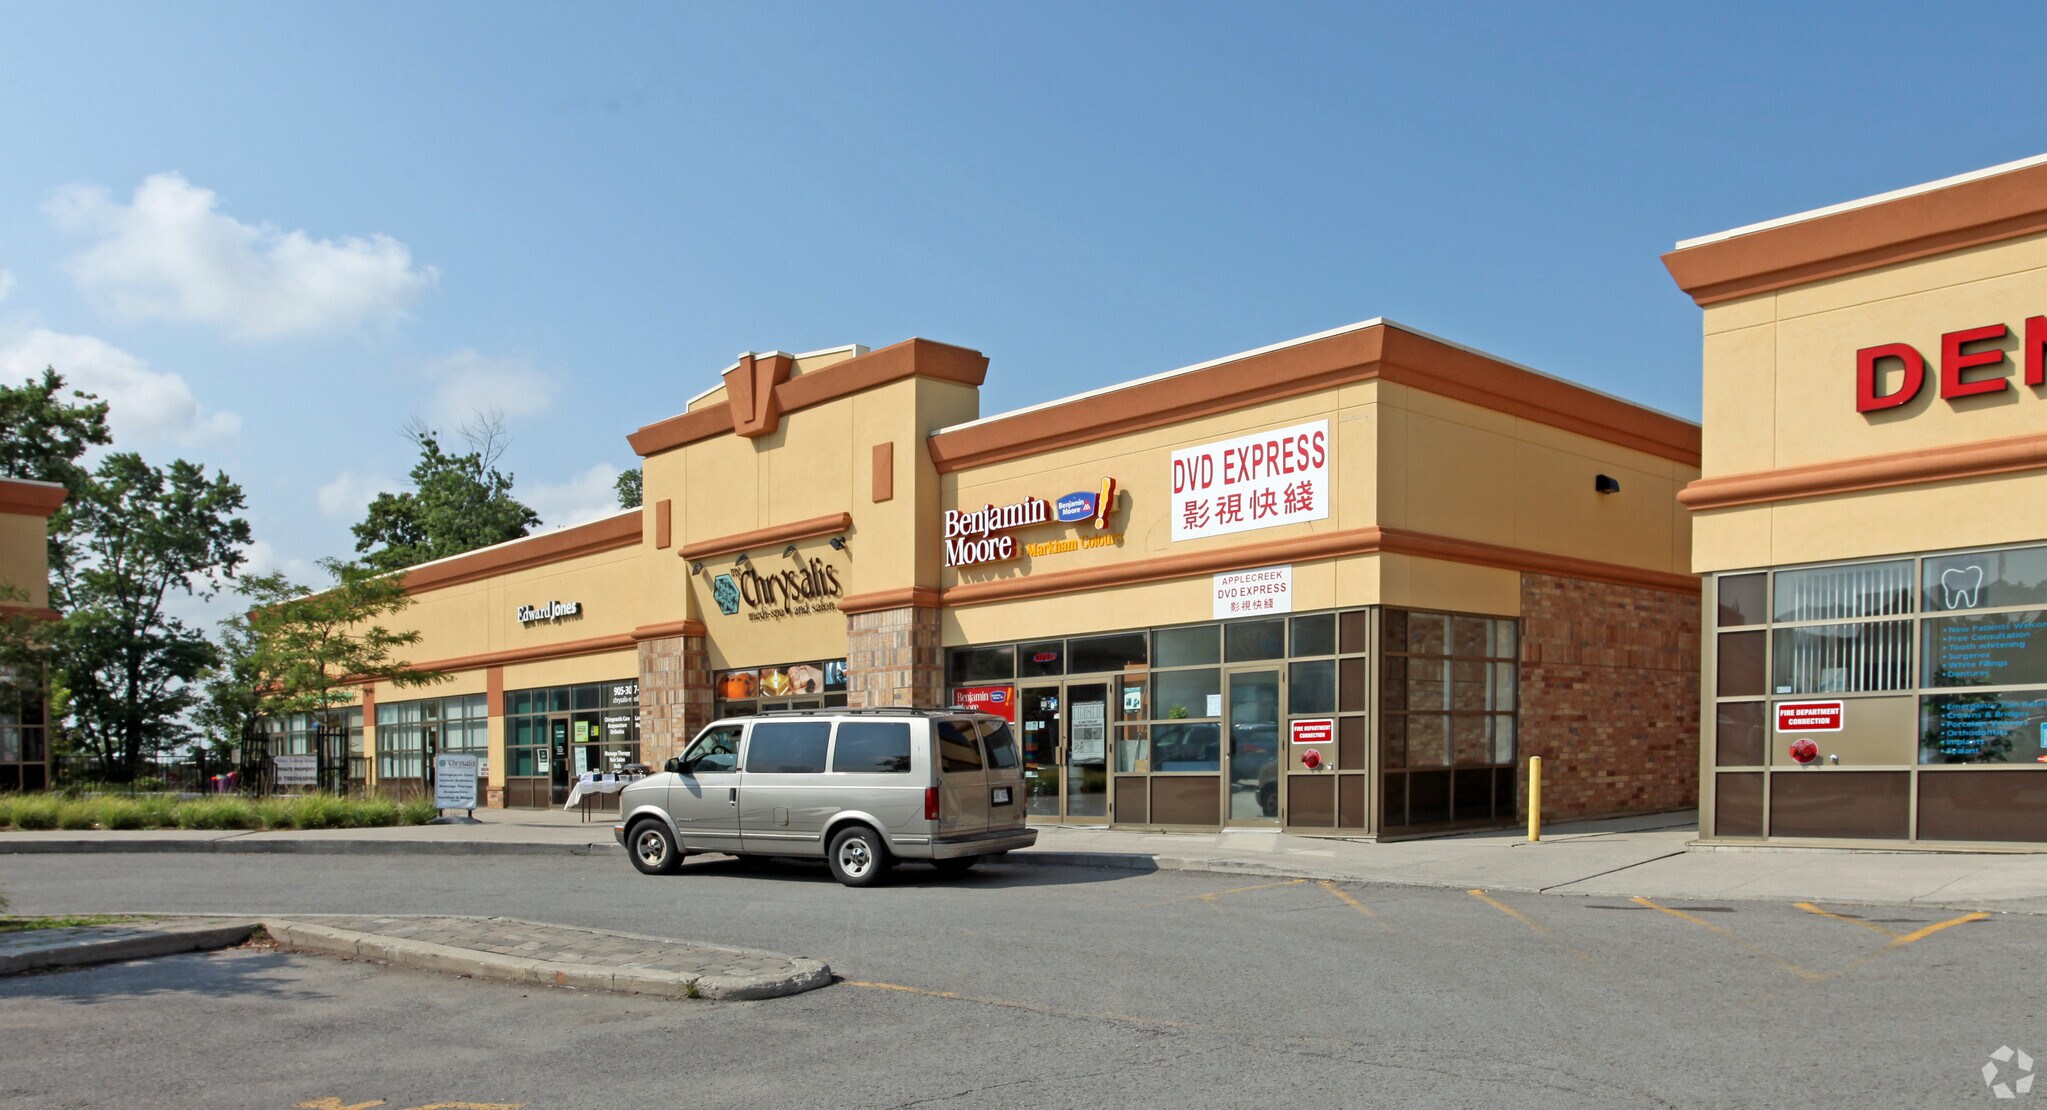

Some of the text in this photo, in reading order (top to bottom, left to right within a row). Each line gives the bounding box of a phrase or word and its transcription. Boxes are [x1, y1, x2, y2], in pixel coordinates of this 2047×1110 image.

[1173, 430, 1326, 495] DVD EXPRESS
[1058, 498, 1084, 509] Benjamin
[1183, 480, 1314, 530] 影視快綫
[1062, 507, 1081, 515] Moore
[945, 496, 1047, 538] Benjamin
[945, 535, 1012, 567] Moore
[1027, 538, 1078, 557] Markham
[1221, 571, 1283, 586] APPLECREEK
[741, 557, 841, 614] Chrysalis
[1218, 583, 1287, 599] DVD EXPRESS
[517, 600, 577, 622] Edward Jones
[794, 602, 811, 615] and
[812, 600, 836, 613] salon
[1972, 623, 2010, 631] Patients
[1971, 632, 2031, 641] Consultation
[1949, 641, 2026, 651] Tooth whitening
[1948, 652, 1990, 660] Surgeries
[1947, 670, 1989, 678] Dentures
[957, 691, 989, 704] Benjamin
[1946, 703, 1998, 711] Emergency
[1780, 708, 1839, 717] FIRE DEPARTMENT
[1995, 710, 2030, 719] Bridges
[1788, 717, 1830, 725] CONNECTION
[1991, 719, 2030, 727] Veneers
[1946, 747, 1979, 755] Sealant
